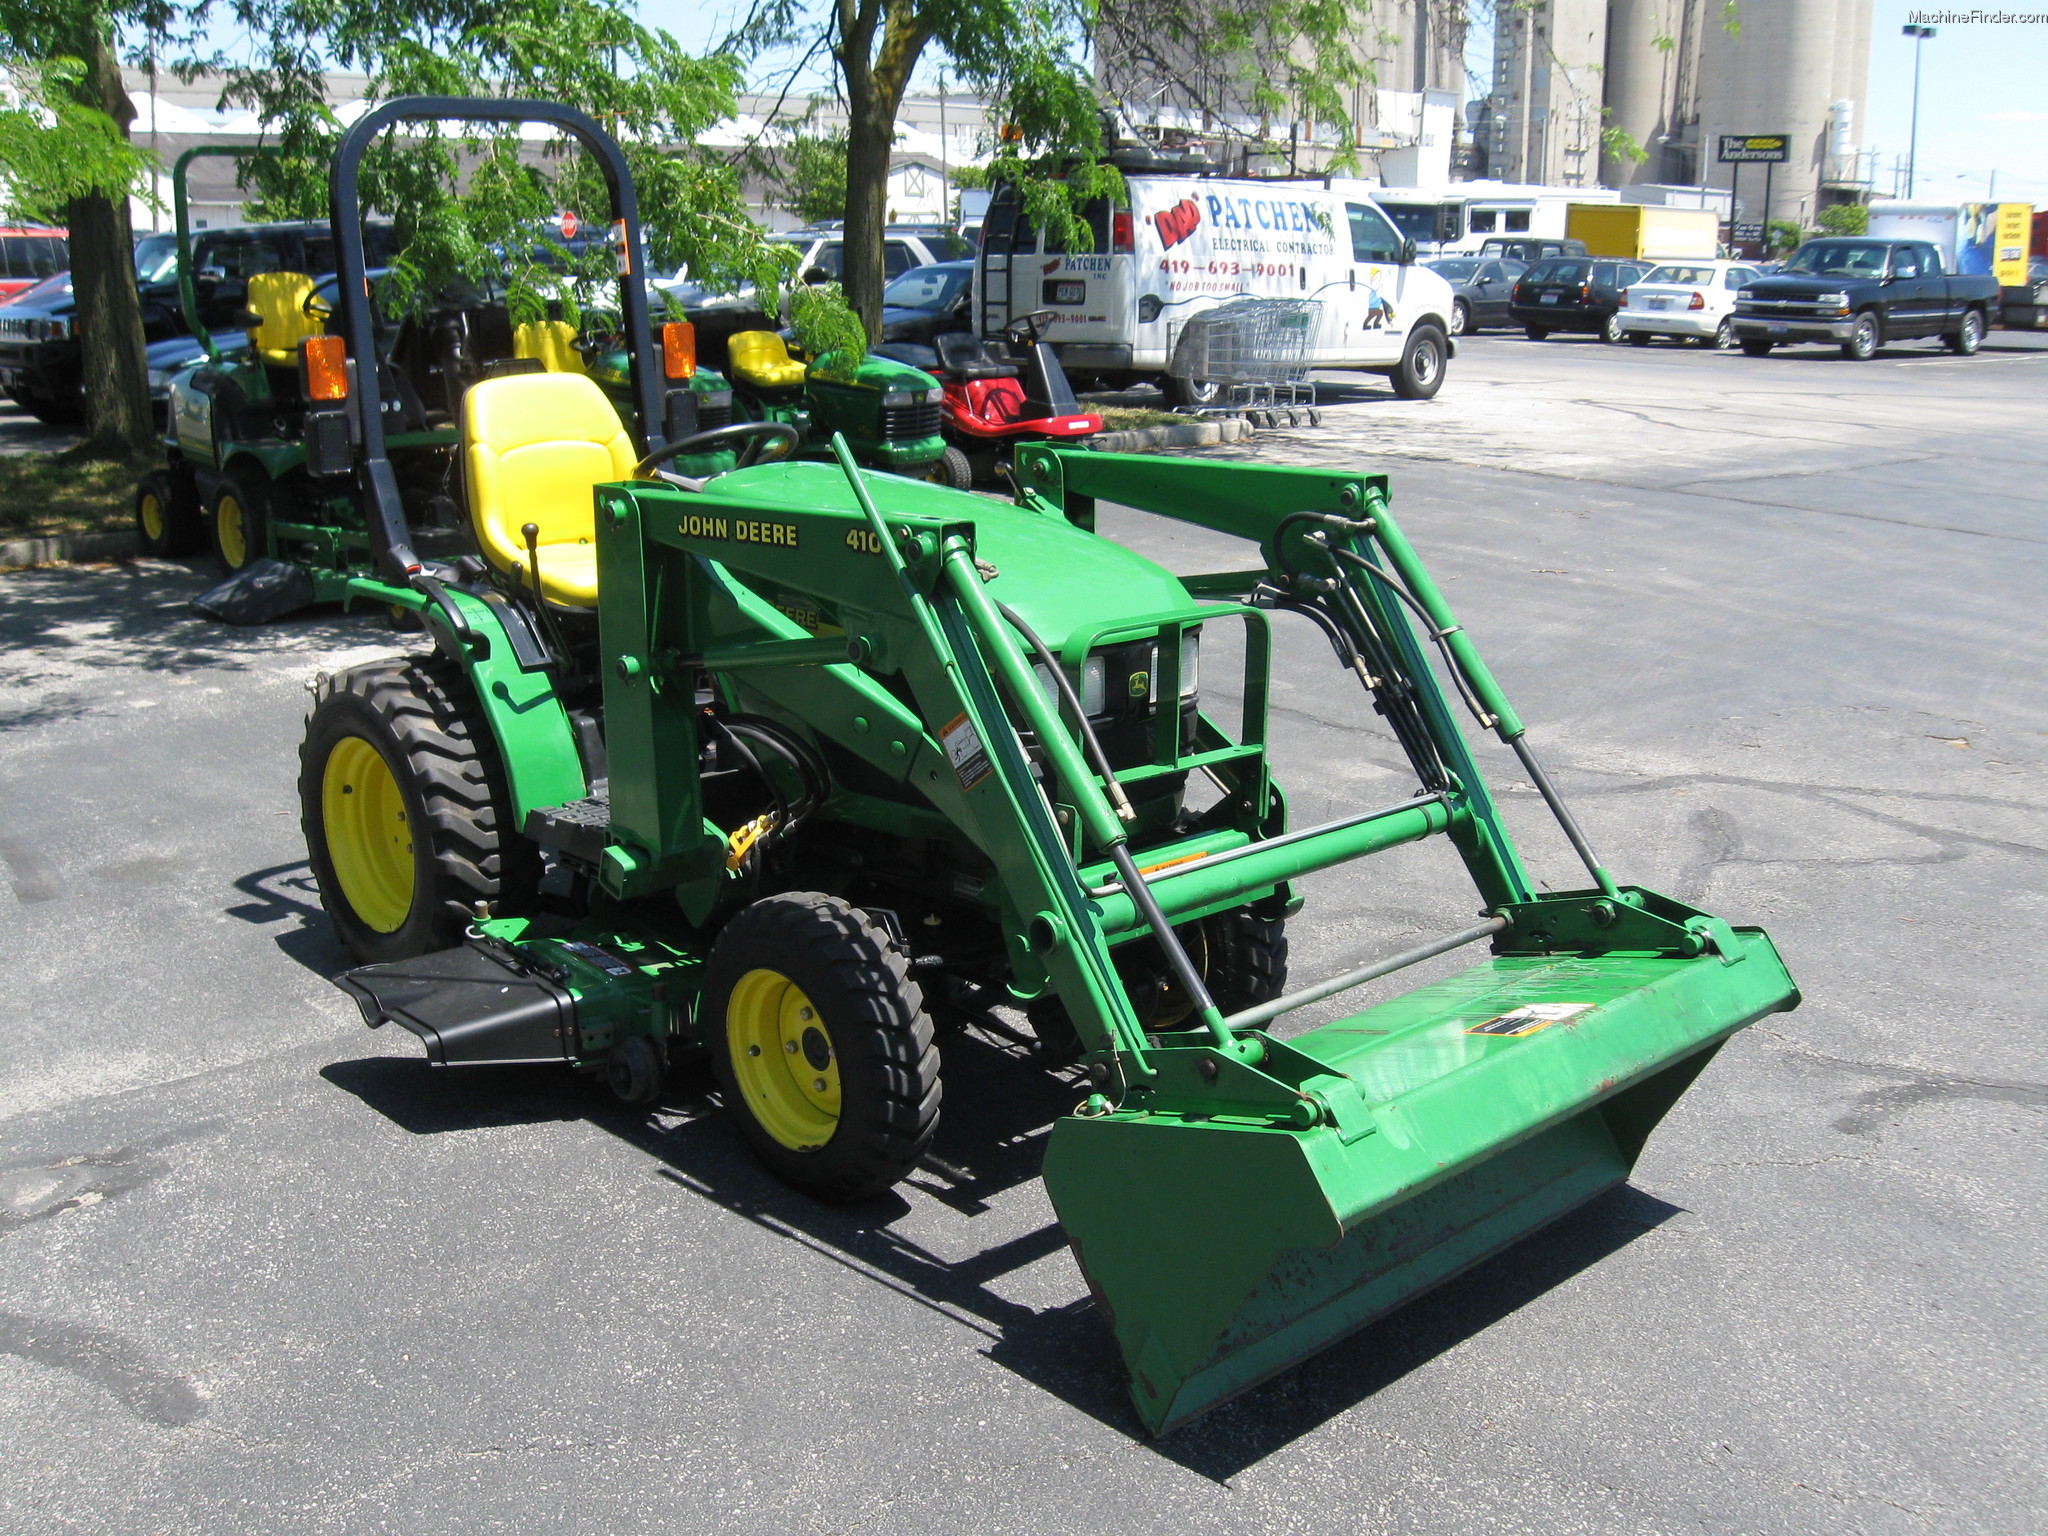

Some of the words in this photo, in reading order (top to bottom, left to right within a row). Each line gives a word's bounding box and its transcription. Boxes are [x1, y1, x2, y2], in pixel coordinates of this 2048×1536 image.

[1721, 138, 1744, 149] The
[1720, 148, 1784, 160] Andersons
[1205, 195, 1322, 233] PATCHEN
[1212, 237, 1270, 253] ELECTRICAL
[1276, 241, 1335, 256] CONTRACTOR
[1064, 257, 1112, 271] PATCHEN
[678, 515, 727, 539] JOHN
[736, 520, 798, 546] DEERE
[846, 528, 882, 553] 410
